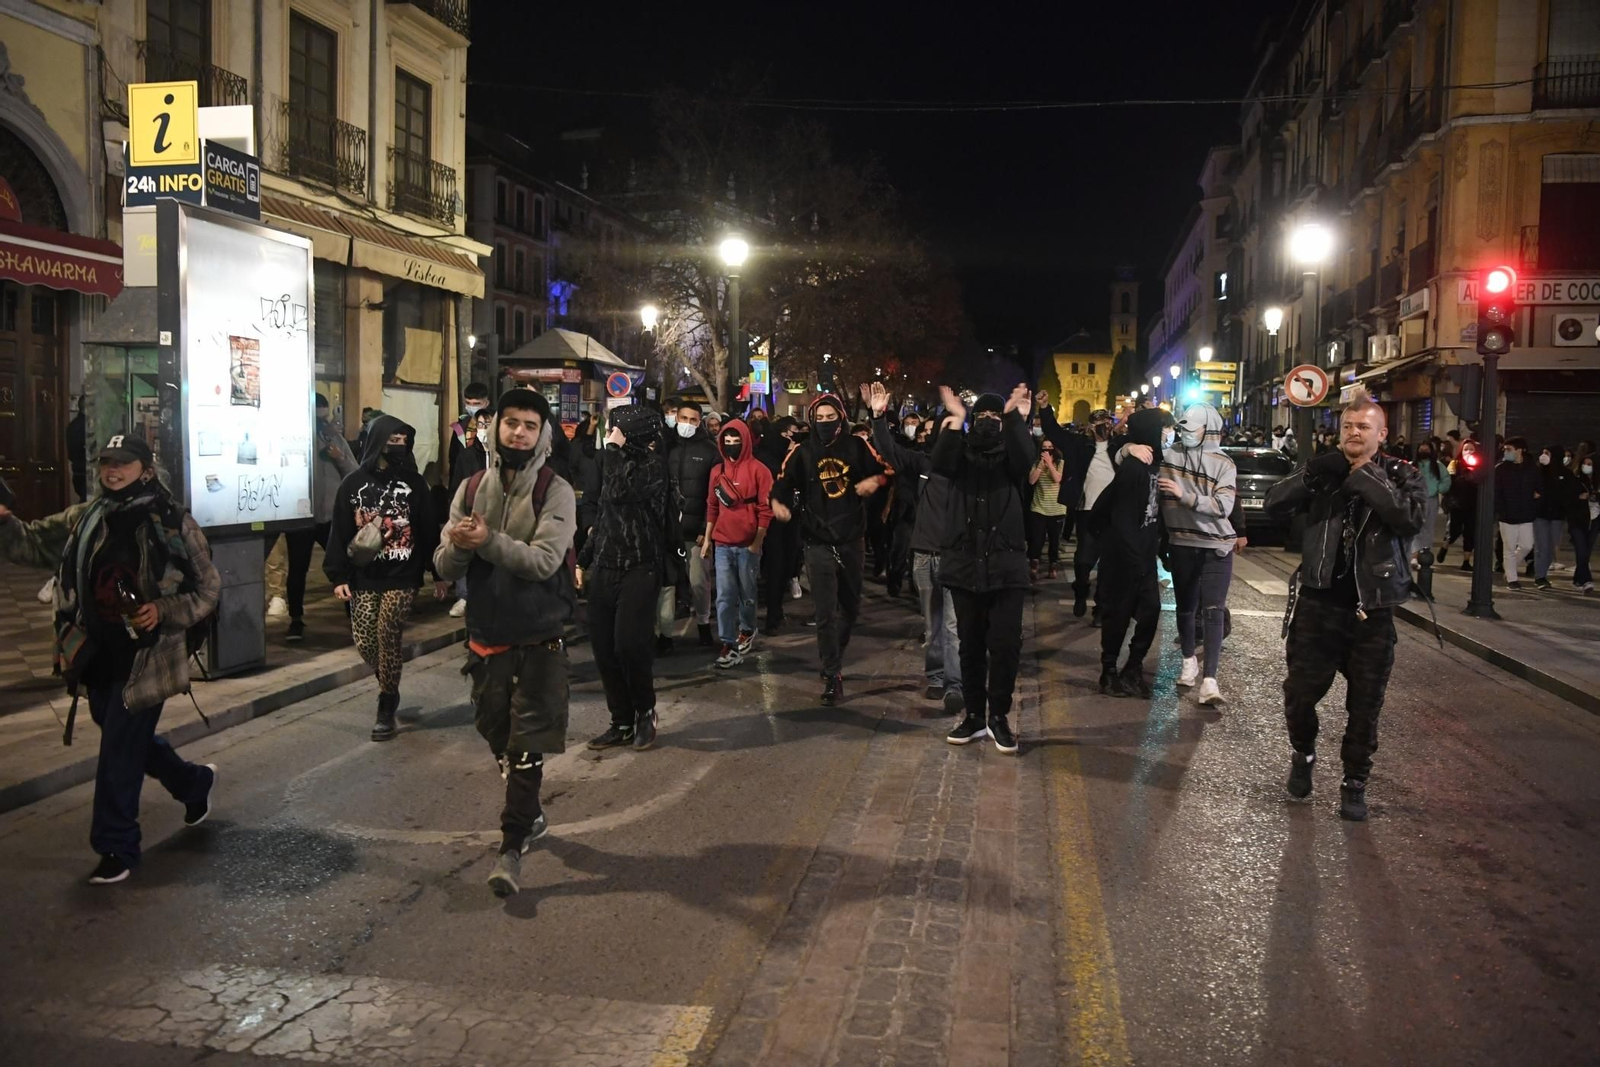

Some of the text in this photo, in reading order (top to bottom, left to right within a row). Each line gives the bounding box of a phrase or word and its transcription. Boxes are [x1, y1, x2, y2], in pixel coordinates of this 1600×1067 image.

[206, 151, 246, 179] CARGA
[127, 173, 203, 194] 24h INFO
[206, 168, 246, 194] GRATIS
[0, 250, 98, 284] SHAWARMA
[1541, 282, 1562, 301] DE
[786, 381, 804, 389] WC
